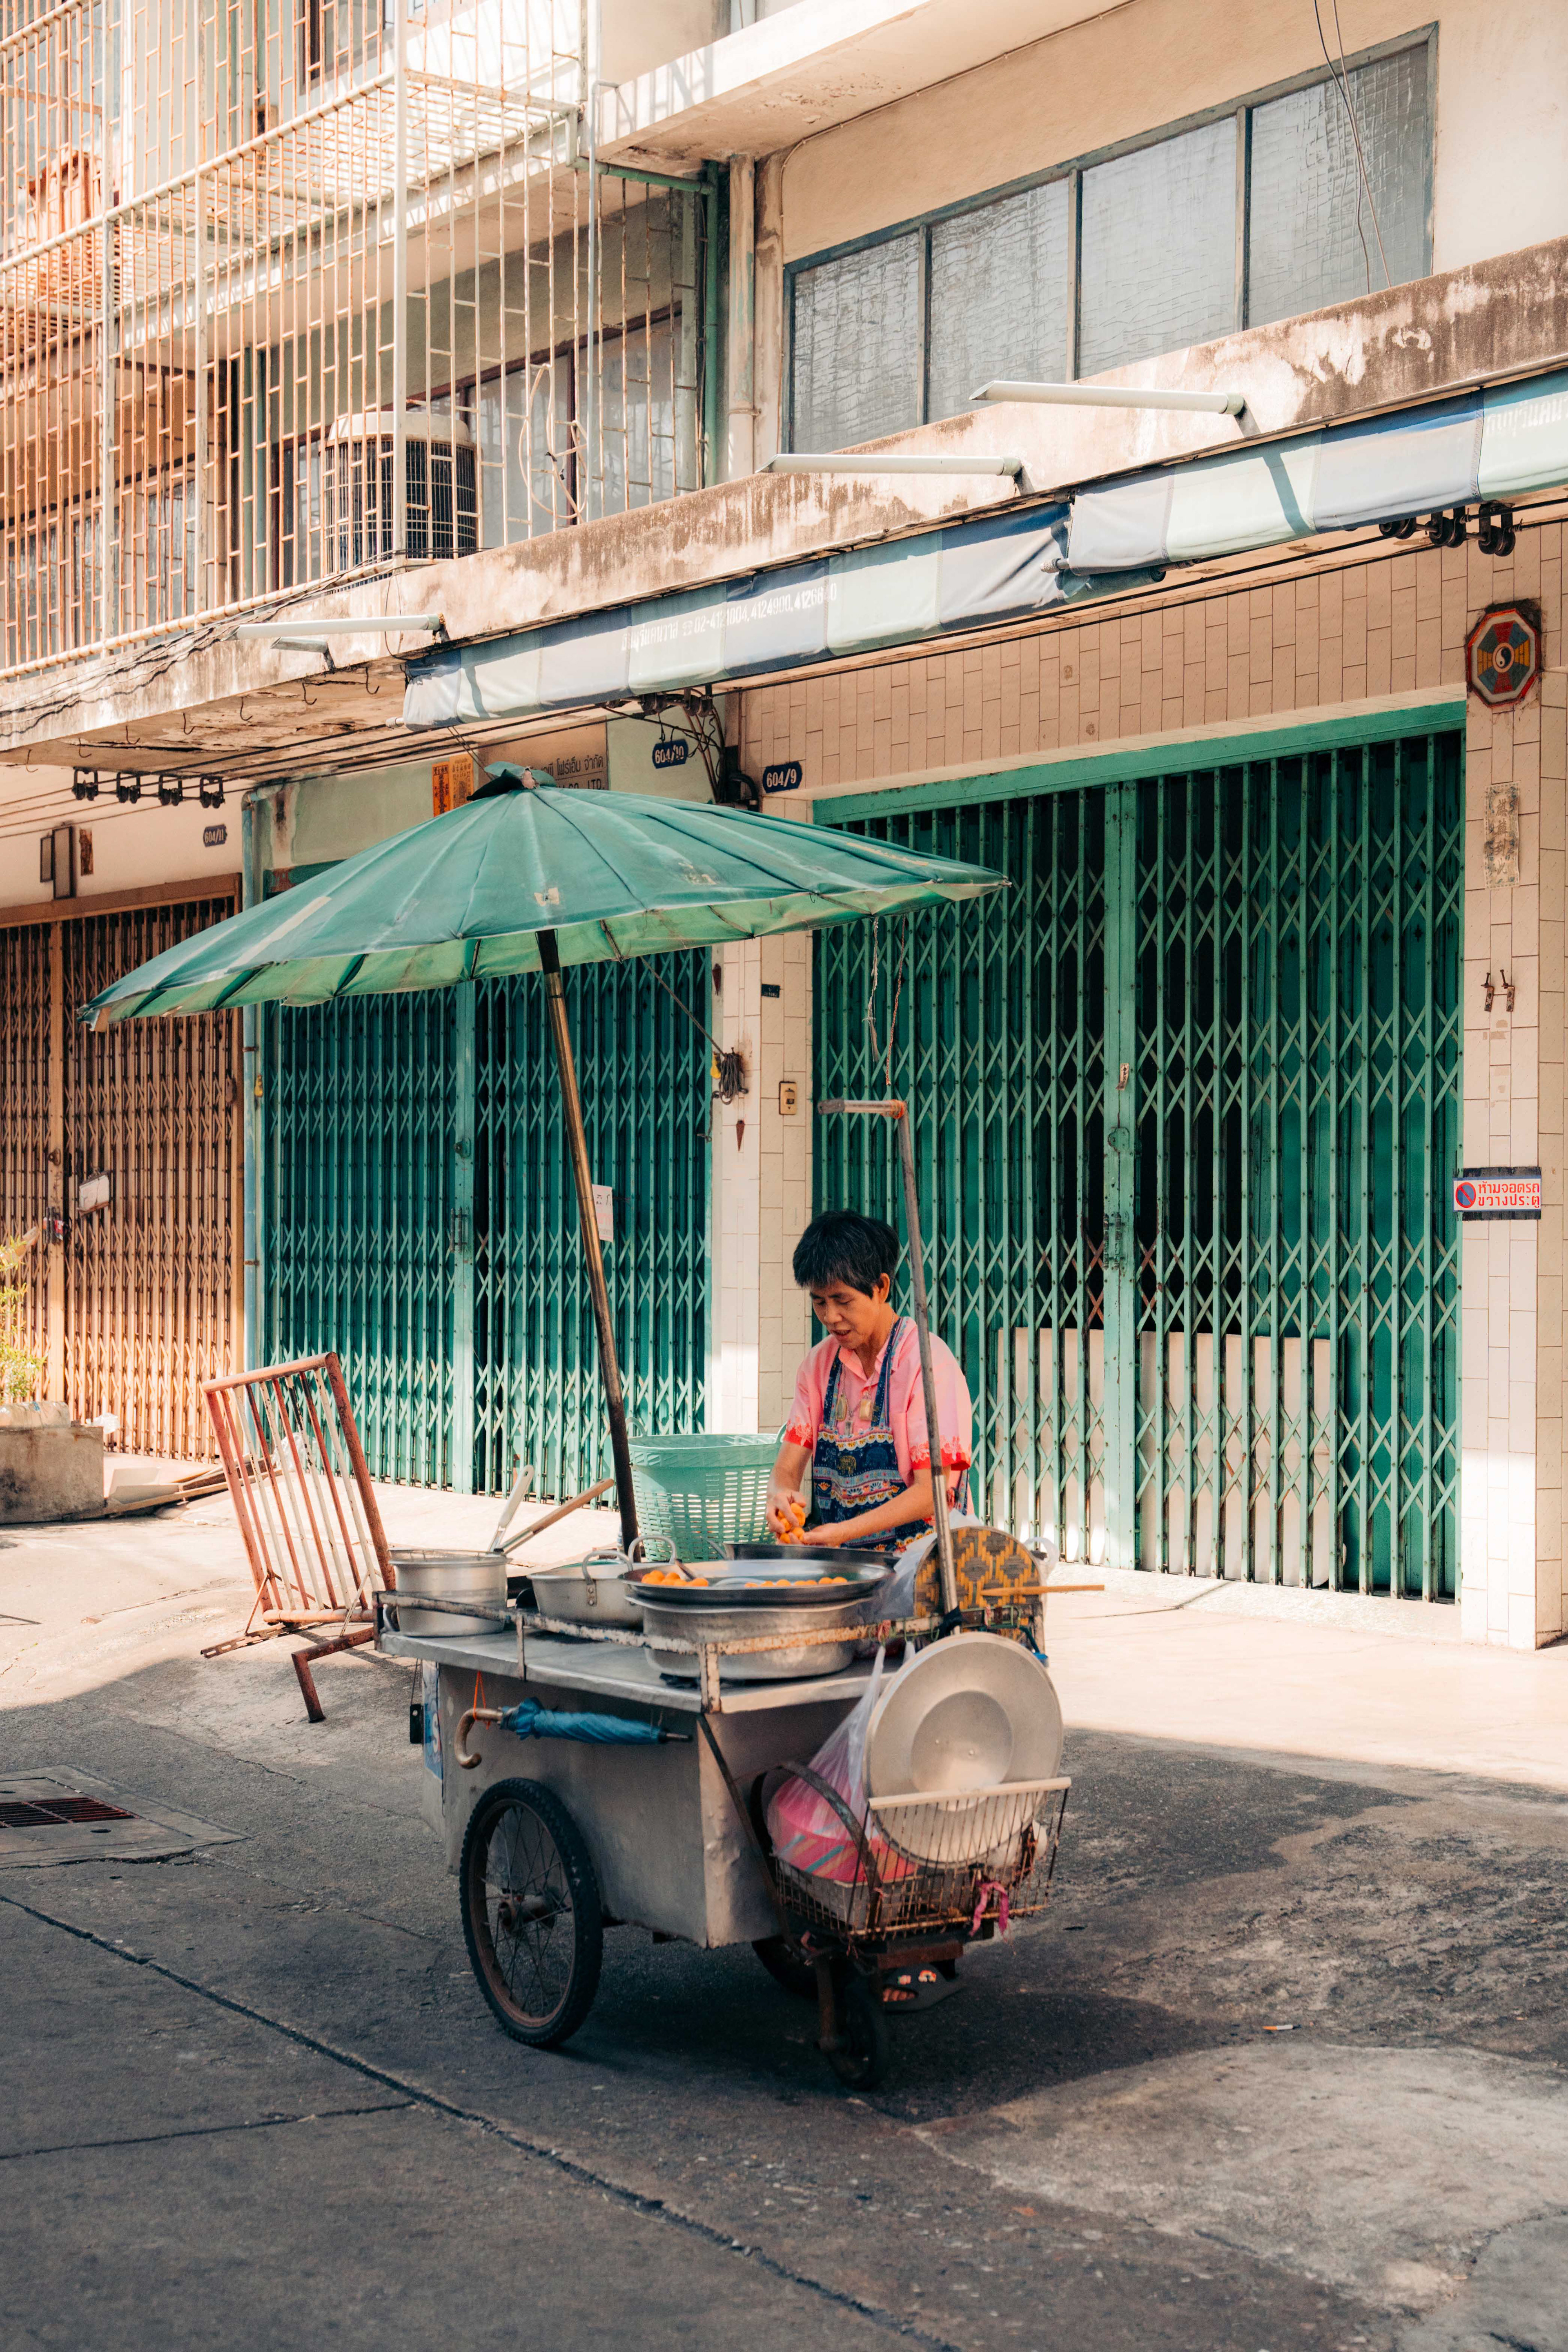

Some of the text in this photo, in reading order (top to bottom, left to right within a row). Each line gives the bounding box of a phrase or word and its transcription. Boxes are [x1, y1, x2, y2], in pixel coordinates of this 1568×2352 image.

[585, 755, 604, 771] จำกัด
[766, 769, 796, 787] 604/9
[205, 829, 224, 843] 604/11
[1478, 1181, 1539, 1194] ห้ามจอดรถ
[1478, 1194, 1539, 1208] ขวางประตู
